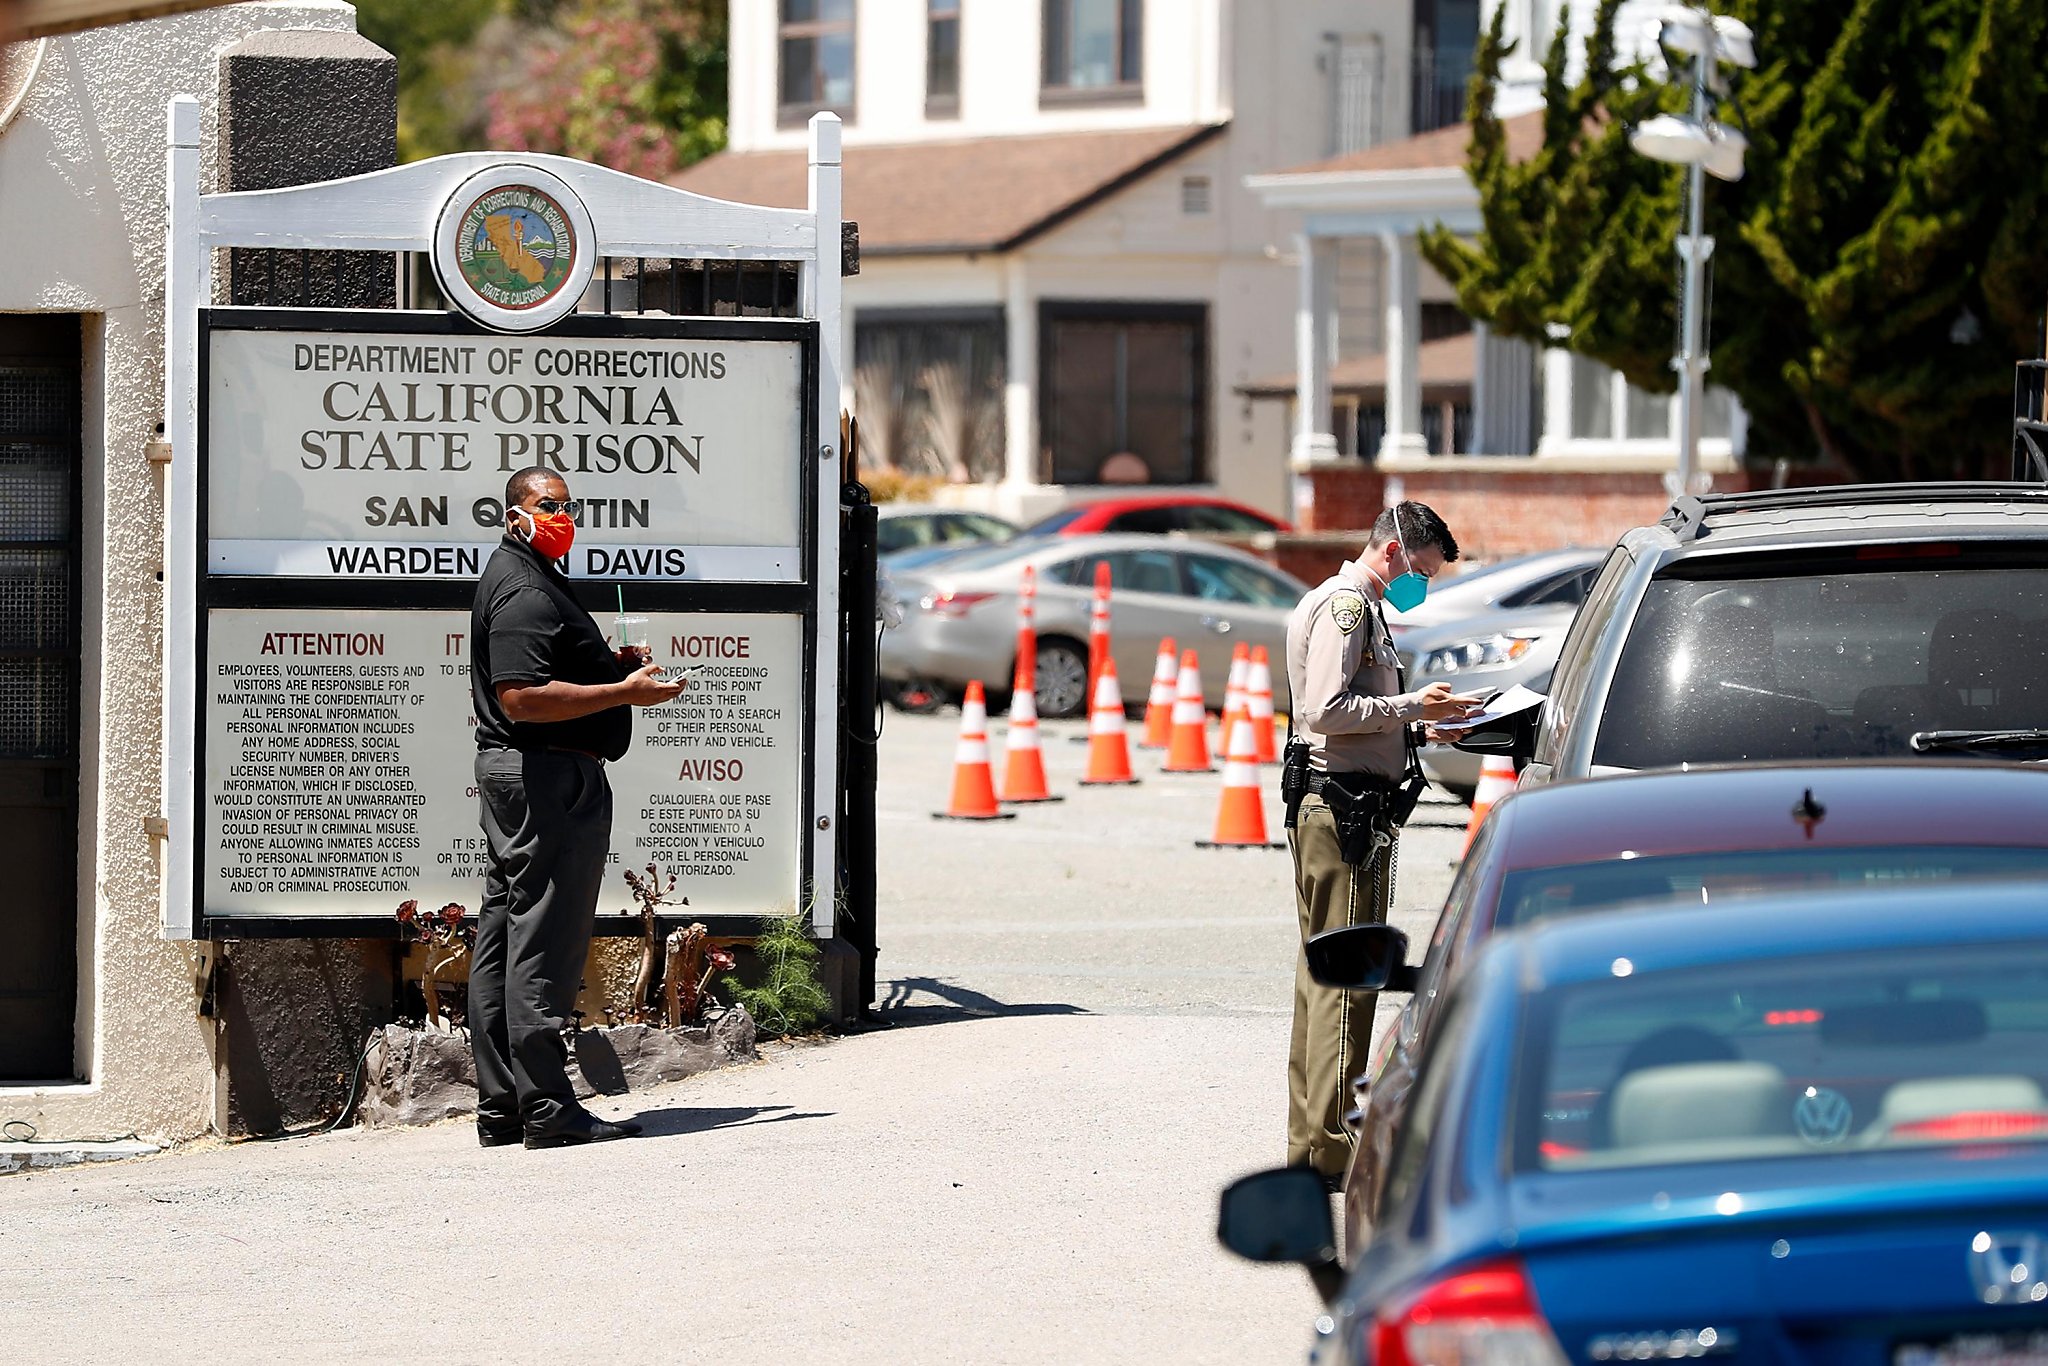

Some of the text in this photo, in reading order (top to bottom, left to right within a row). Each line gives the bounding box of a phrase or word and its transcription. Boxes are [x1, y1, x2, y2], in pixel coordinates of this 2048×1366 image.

[459, 191, 571, 262] DEPARTMENT OF CORRECTIONS AND REHABILITATION
[480, 282, 548, 305] STATE OF CALIFORNIA
[295, 344, 726, 379] DEPARTMENT OF CORRECTIONS
[323, 381, 683, 426] CALIFORNIA
[301, 430, 704, 475] STATE PRISON
[365, 496, 448, 527] SAN
[327, 546, 479, 575] WARDEN
[587, 548, 685, 576] DAVIS
[261, 633, 384, 656] ATTENTION
[446, 634, 464, 656] IT
[671, 636, 750, 658] NOTICE
[218, 665, 424, 677] EMPLOYEES, VOLUNTEERS, GUESTS AND
[440, 664, 454, 675] TO
[701, 666, 768, 678] PROCEEDING
[233, 679, 409, 691] VISITORS ARE RESPONSIBLE FOR
[704, 680, 727, 691] THIS
[732, 681, 762, 691] POINT
[217, 694, 424, 705] MAINTAINING THE CONFIDENTIALITY OF
[717, 695, 746, 705] THEIR
[242, 708, 400, 719] ALL PERSONAL INFORMATION.
[642, 708, 780, 719] PERMISSION TO A SEARCH
[227, 722, 414, 734] PERSONAL INFORMATION INCLUDES
[658, 722, 764, 733] OF THEIR PERSONAL
[241, 737, 400, 749] ANY HOME ADDRESS, SOCIAL
[646, 736, 775, 747] PROPERTY AND VEHICLE.
[242, 751, 399, 763] SECURITY NUMBER, DRIVER'S
[231, 765, 410, 777] LICENSE NUMBER OR ANY OTHER
[679, 759, 743, 781] AVISO
[224, 780, 416, 792] INFORMATION, WHICH IF DISCLOSED,
[214, 794, 426, 806] WOULD CONSTITUTE AN UNWARRANTED
[650, 794, 771, 805] CUALQUIERA QUE PASE
[223, 808, 417, 820] INVASION OF PERSONAL PRIVACY OR
[641, 809, 760, 819] DE ESTE PUNTO DA SU
[222, 823, 418, 835] COULD RESULT IN CRIMINAL MISUSE.
[649, 822, 751, 833] CONSENTIMIENTO A
[220, 837, 420, 849] ANYONE ALLOWING INMATES ACCESS
[453, 839, 462, 849] IT
[466, 839, 475, 850] IS
[636, 837, 764, 847] INSPECCION Y VEHICULO
[238, 852, 402, 864] TO PERSONAL INFORMATION IS
[437, 853, 452, 864] OR
[456, 853, 470, 864] TO
[651, 851, 749, 862] POR EL PERSONAL
[220, 866, 419, 878] SUBJECT TO ADMINISTRATIVE ACTION
[451, 867, 473, 877] ANY
[666, 865, 735, 876] AUTORIZADO.
[230, 880, 410, 893] AND/OR CRIMINAL PROSECUTION.
